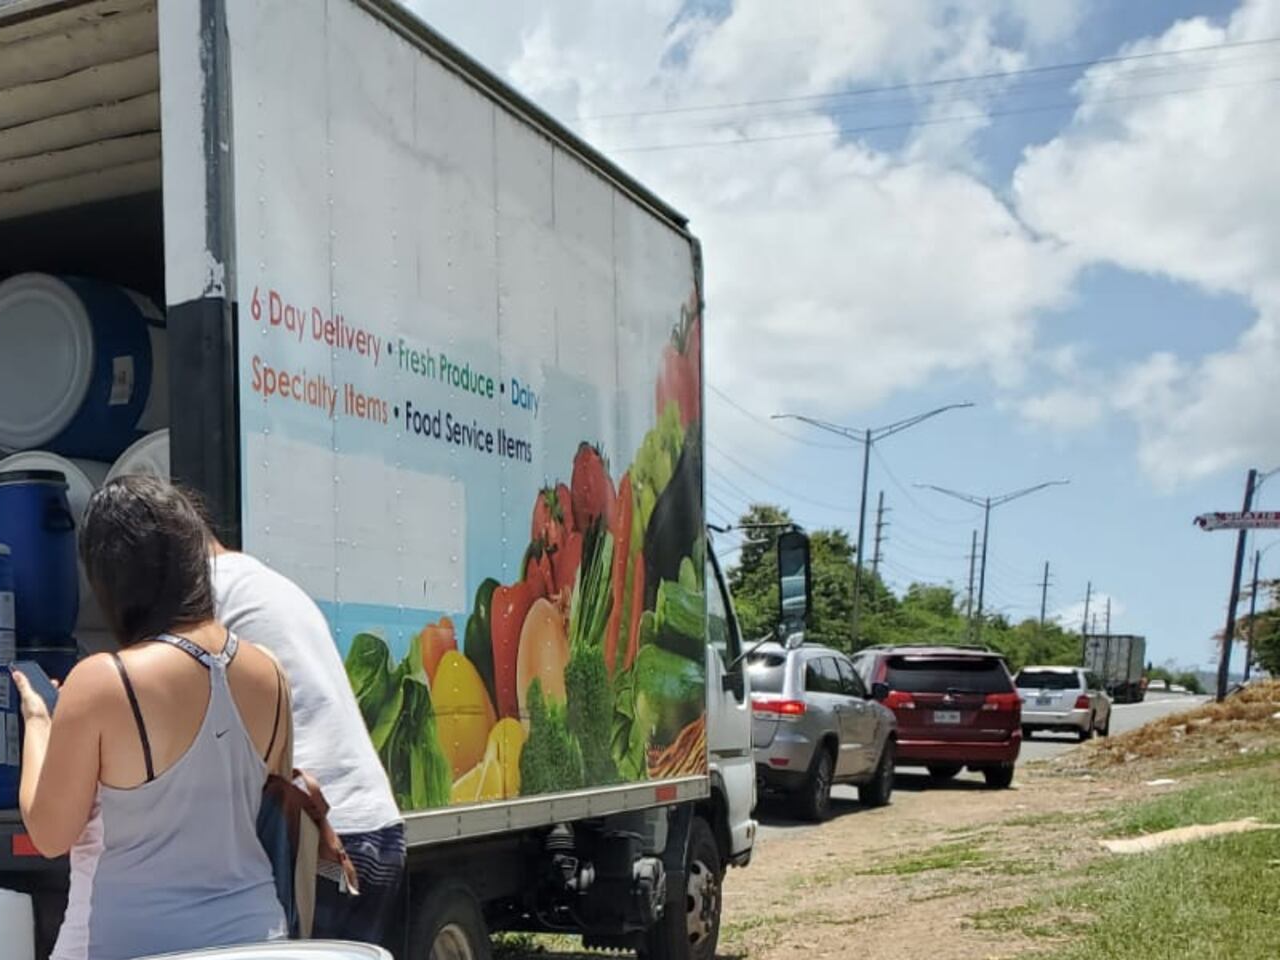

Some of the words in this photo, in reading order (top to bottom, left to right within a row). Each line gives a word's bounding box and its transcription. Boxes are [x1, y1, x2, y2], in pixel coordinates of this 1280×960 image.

[251, 286, 262, 321] 6
[269, 290, 306, 343] Day
[312, 306, 381, 367] Delivery
[398, 339, 436, 379] Fresh
[439, 353, 494, 399] Produce
[511, 377, 540, 420] Dairy
[251, 355, 338, 419] Specialty
[344, 383, 389, 424] Items
[405, 401, 441, 439] Food
[445, 412, 494, 453] Service
[497, 427, 532, 463] Items
